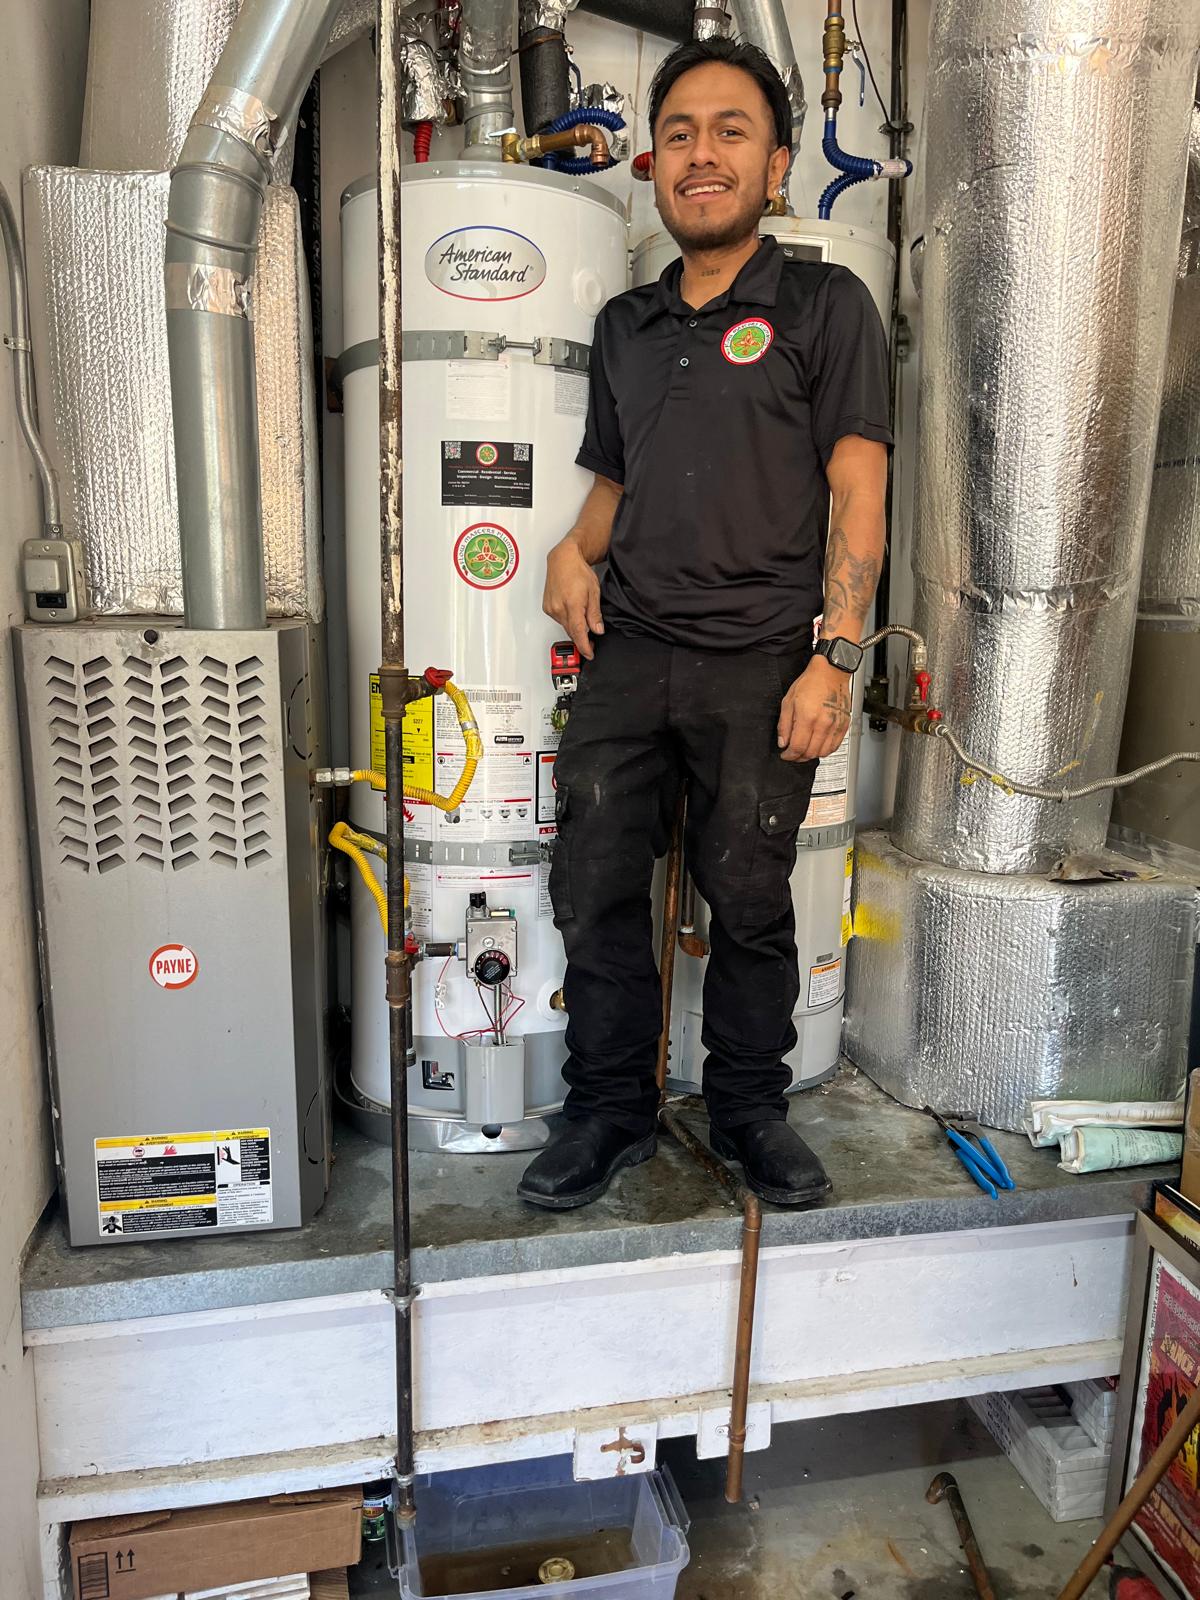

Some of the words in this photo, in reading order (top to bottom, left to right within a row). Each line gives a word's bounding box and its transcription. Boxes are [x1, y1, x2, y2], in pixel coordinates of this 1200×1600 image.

[439, 243, 512, 265] American
[450, 262, 529, 283] Standard
[156, 959, 192, 974] PAYNE
